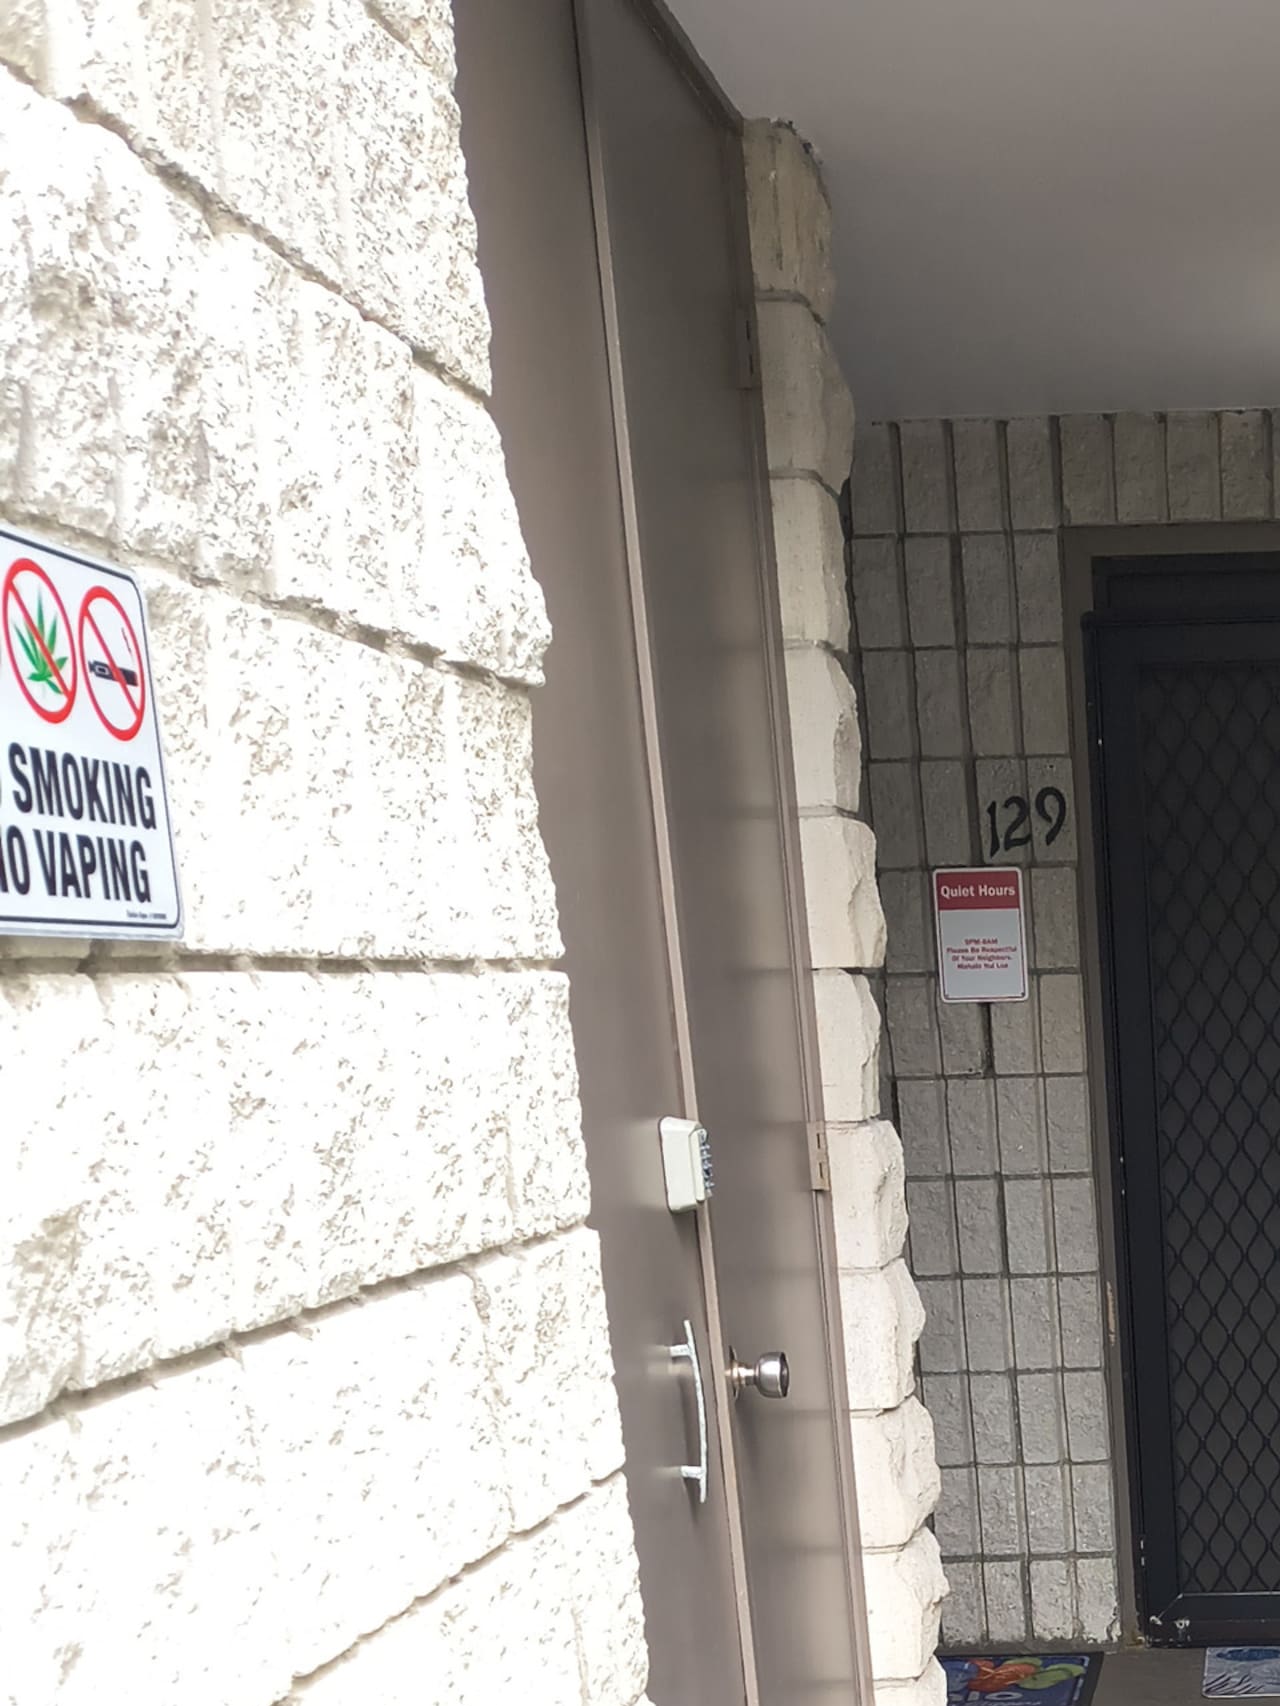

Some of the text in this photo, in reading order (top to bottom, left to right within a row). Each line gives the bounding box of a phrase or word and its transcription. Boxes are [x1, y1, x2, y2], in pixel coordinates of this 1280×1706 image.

[9, 742, 157, 830] SMOKING
[987, 786, 1066, 858] 129
[33, 828, 151, 903] VAPING
[941, 884, 1016, 900] Quiet Hours
